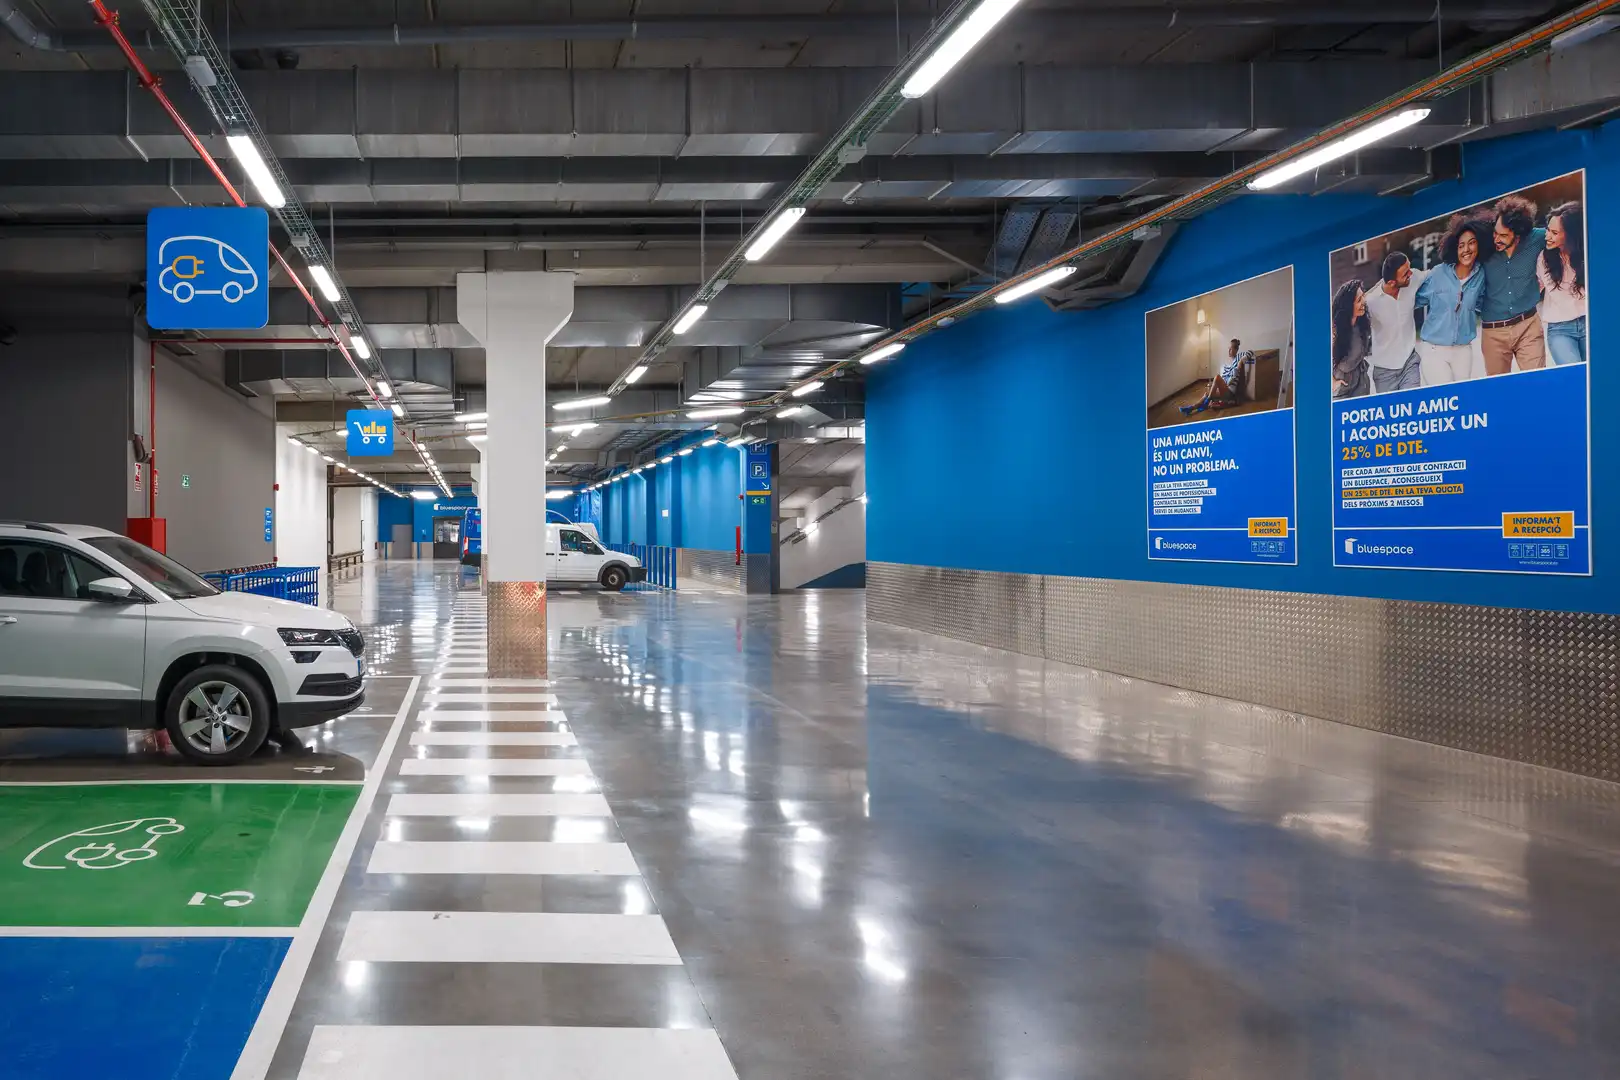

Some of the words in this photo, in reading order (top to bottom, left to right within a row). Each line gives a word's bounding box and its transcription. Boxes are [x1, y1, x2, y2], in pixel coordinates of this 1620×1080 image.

[1342, 407, 1385, 424] PORTA
[1390, 403, 1412, 418] UN
[1418, 396, 1459, 415] AMIC
[1341, 430, 1345, 442] I
[1350, 416, 1455, 441] ACONSEGUEIX
[1461, 412, 1488, 430] UN
[1153, 437, 1172, 448] UNA
[1175, 430, 1222, 446] MUDANÇA
[1153, 449, 1162, 462] ÉS
[1165, 450, 1178, 460] UN
[1181, 446, 1212, 459] CANVI,
[1342, 445, 1370, 460] 25%
[1376, 443, 1392, 457] DE
[1398, 440, 1428, 456] DTE.
[1154, 466, 1167, 476] NO
[1170, 464, 1183, 474] UN
[1186, 459, 1239, 473] PROBLEMA.
[1423, 461, 1464, 471] CONTRACTI
[1355, 478, 1390, 486] BLUESPACE,
[1392, 475, 1441, 484] ACONSEGUEIX
[1522, 525, 1561, 533] RECEPCIÓ
[1163, 542, 1196, 550] bluespace
[1358, 544, 1413, 555] bluespace
